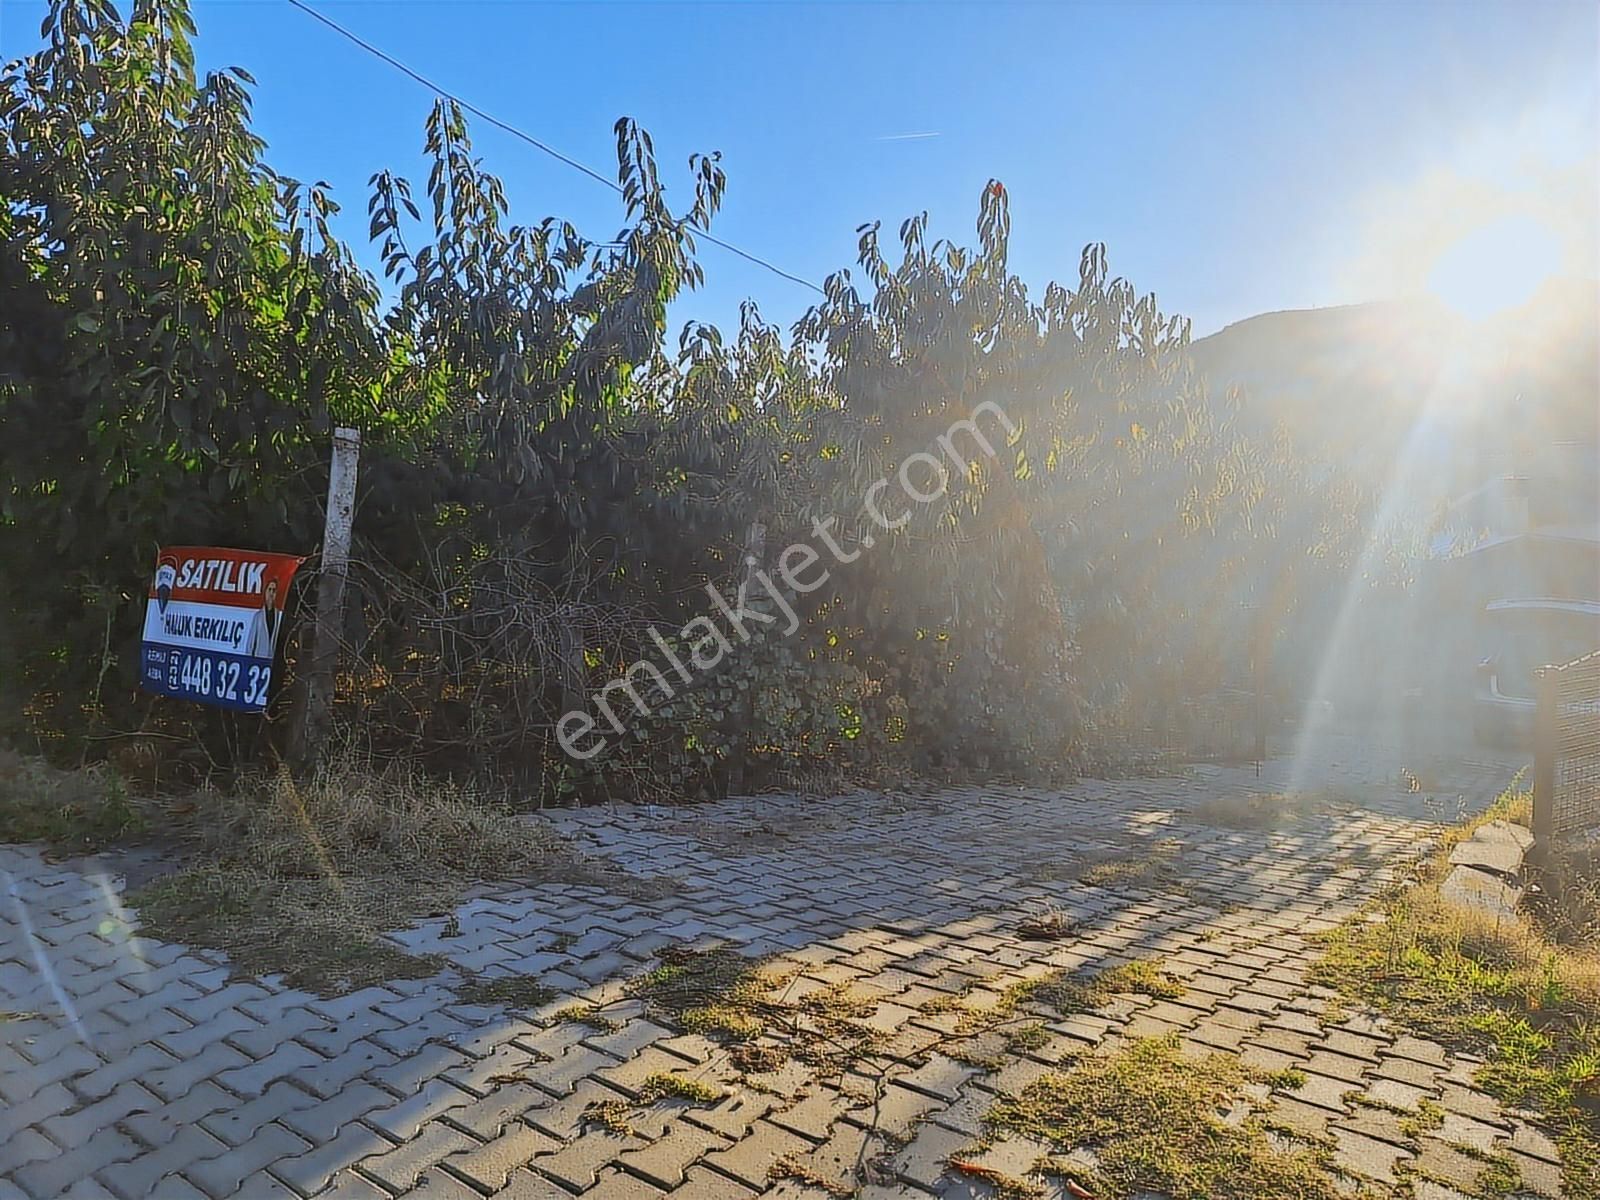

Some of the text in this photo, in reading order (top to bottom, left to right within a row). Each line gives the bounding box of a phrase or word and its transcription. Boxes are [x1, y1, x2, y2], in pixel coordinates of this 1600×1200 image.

[177, 559, 266, 593] SATILIK
[194, 616, 244, 649] ERKILIÇ
[181, 655, 211, 695] 448
[216, 660, 241, 700] 32
[244, 665, 271, 706] 32
